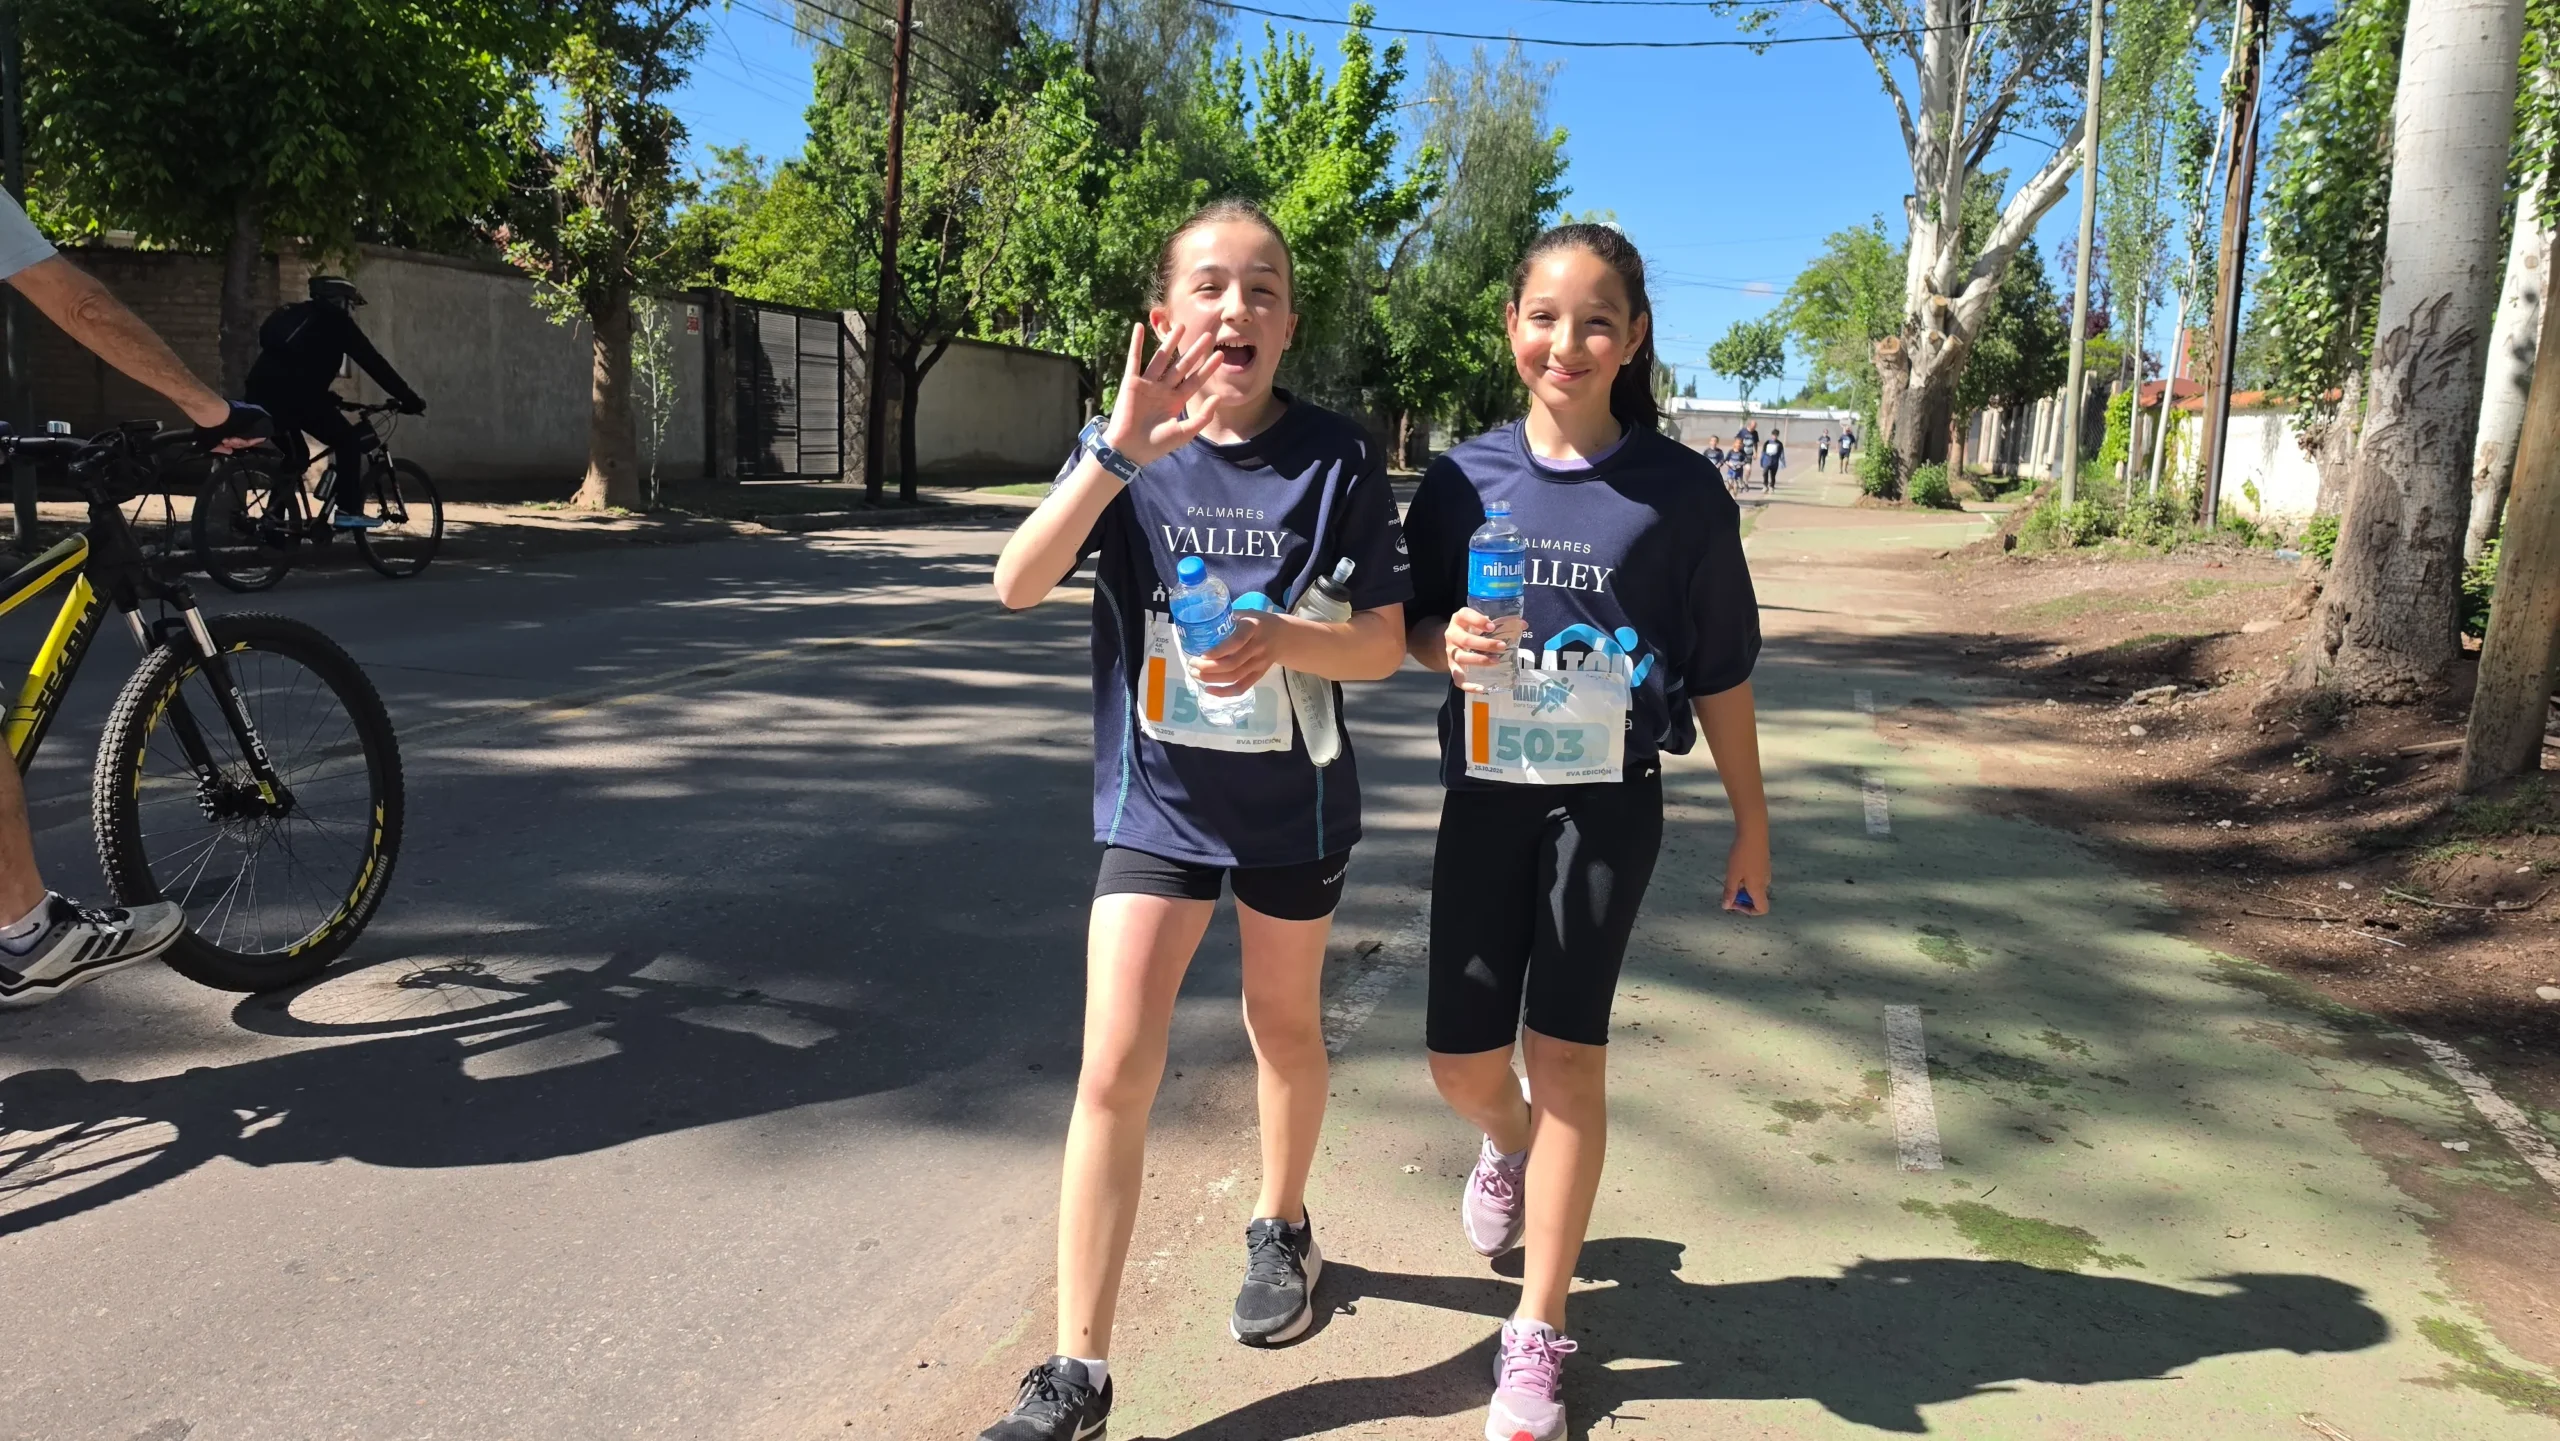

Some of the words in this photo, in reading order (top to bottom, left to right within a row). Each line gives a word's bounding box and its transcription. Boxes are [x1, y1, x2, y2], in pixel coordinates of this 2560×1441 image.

[1187, 506, 1265, 520] PALMARES
[1162, 525, 1288, 558] VALLEY
[1524, 537, 1592, 554] ALMARES
[1483, 561, 1525, 577] nihuil
[246, 729, 274, 772] XCT
[1496, 726, 1585, 763] 503
[1582, 767, 1612, 776] EDICIÓN
